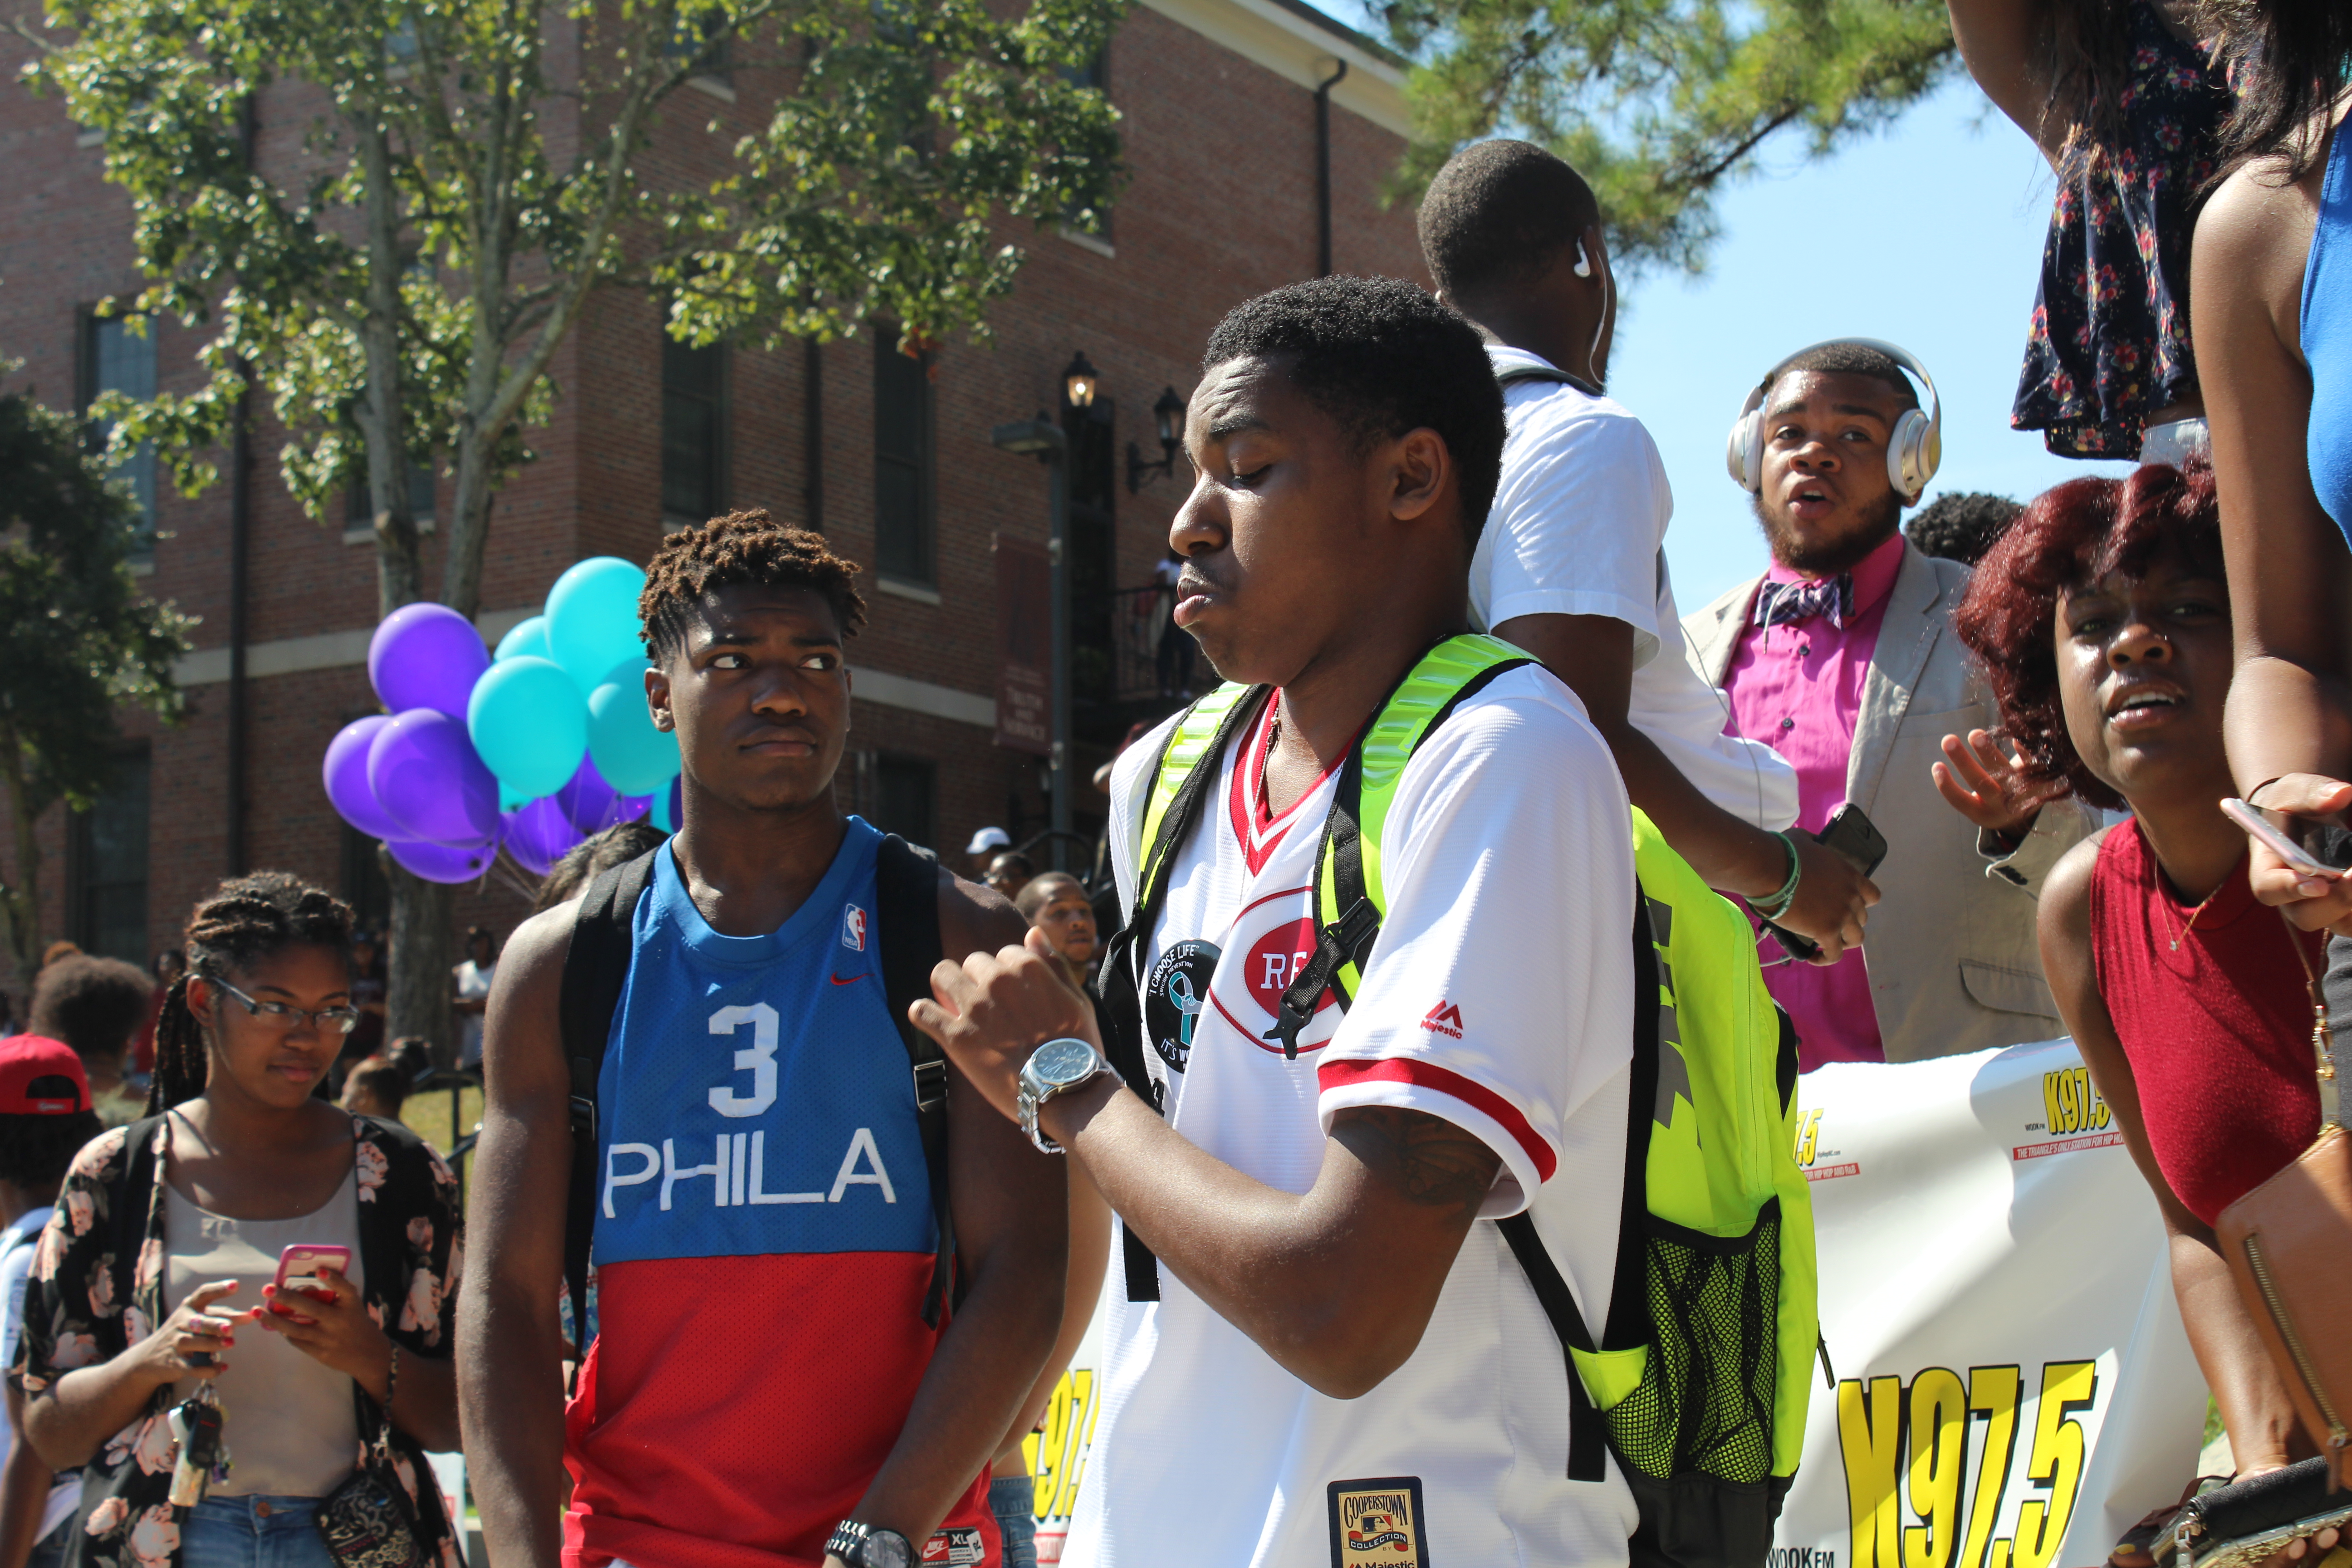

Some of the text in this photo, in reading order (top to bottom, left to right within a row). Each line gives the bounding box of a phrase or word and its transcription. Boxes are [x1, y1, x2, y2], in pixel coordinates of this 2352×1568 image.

[845, 936, 858, 947] NBA
[1152, 949, 1176, 987] CHOOSE
[1160, 961, 1193, 997] SUICIDE PREVENTION
[1420, 1019, 1462, 1039] Majestic
[708, 1001, 779, 1118] 3
[1161, 1039, 1176, 1060] IT'S
[2017, 1133, 2125, 1159] THE TRIANGLE'S ONLY STATION FOR HIP HO
[603, 1128, 896, 1219] PHILA
[1814, 1170, 1823, 1179] HIP
[1823, 1168, 1833, 1178] HOP
[1834, 1166, 1845, 1176] AND
[1344, 1494, 1408, 1528] COOPERSTOWN
[927, 1540, 944, 1551] NIKE
[951, 1534, 968, 1545] XL
[1351, 1533, 1406, 1548] COLLECTION
